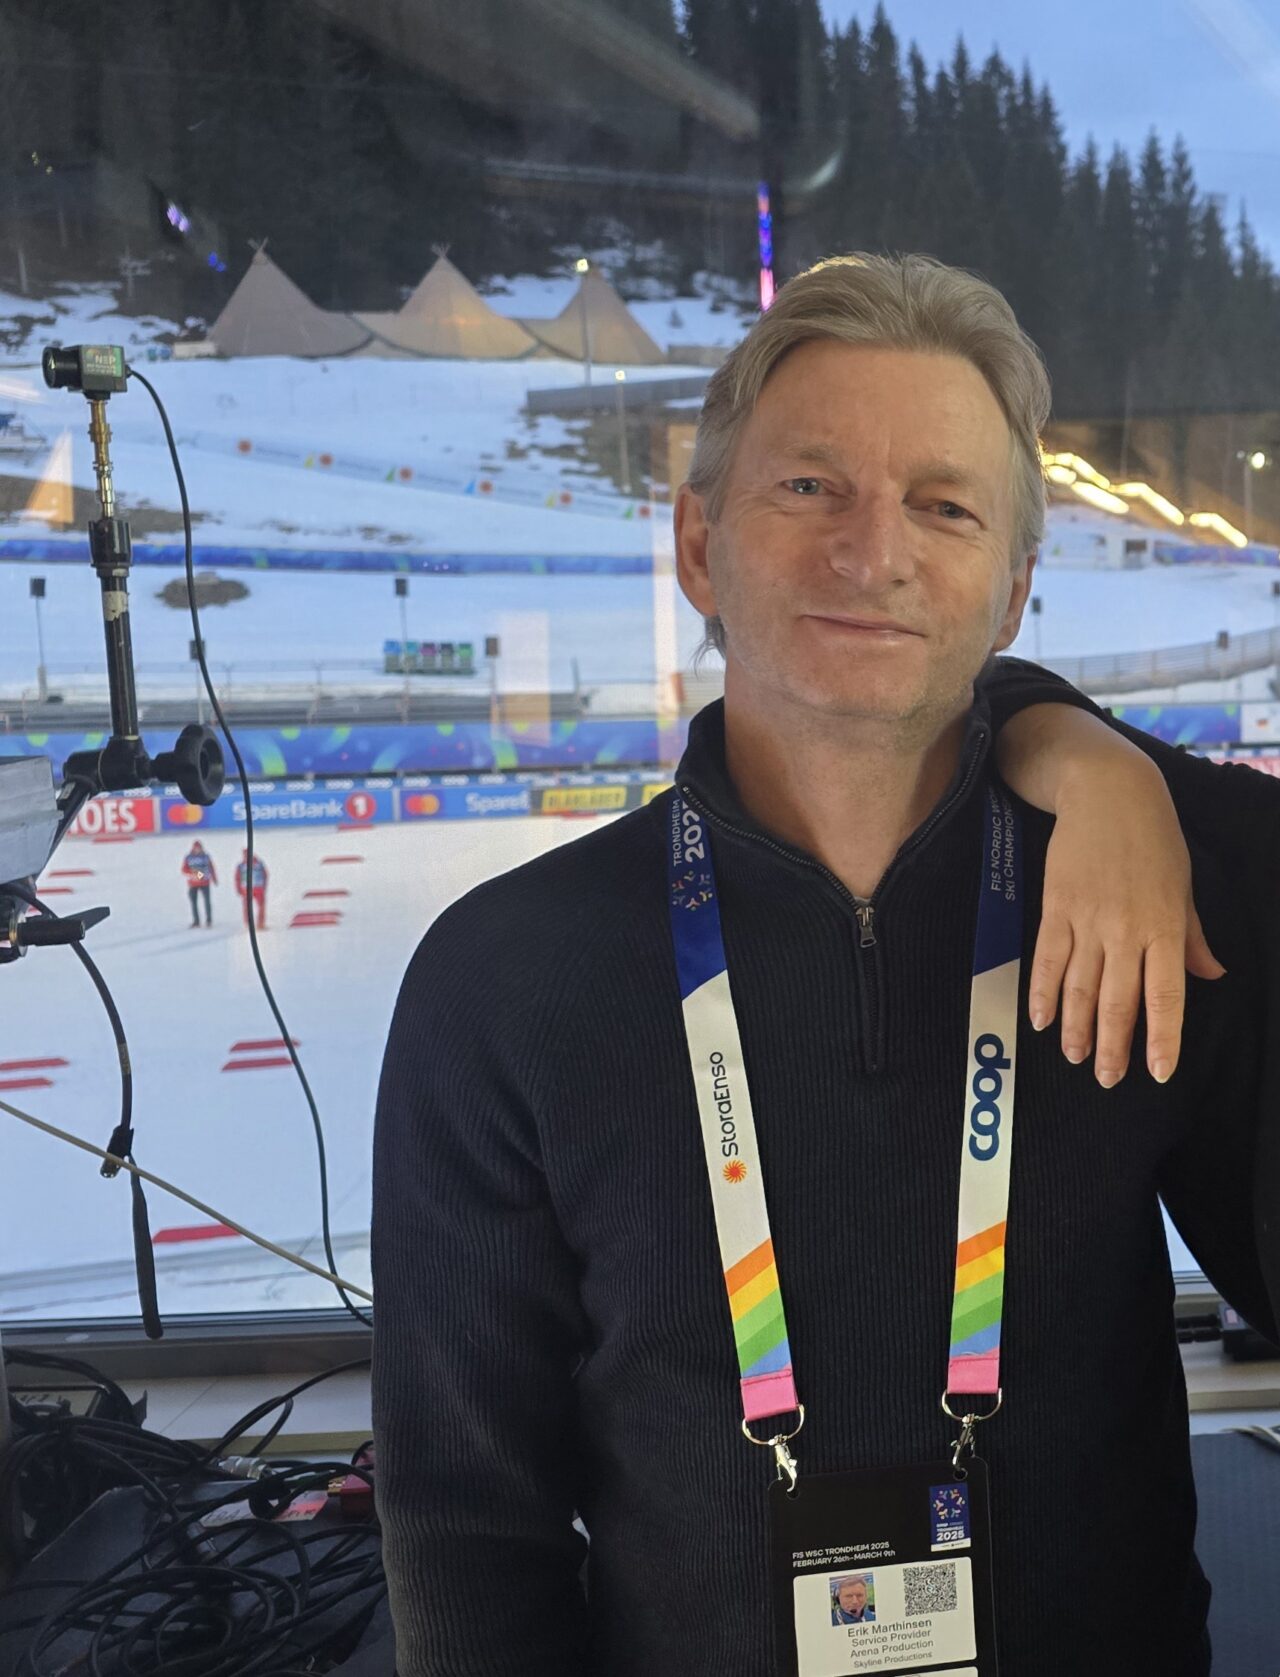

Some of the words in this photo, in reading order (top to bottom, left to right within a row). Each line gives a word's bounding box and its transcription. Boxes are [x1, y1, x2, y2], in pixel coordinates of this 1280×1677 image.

[671, 799, 682, 867] TRONDHEIM
[682, 800, 705, 863] 202
[990, 816, 1002, 869] NORDIC
[990, 871, 1002, 891] FIS
[1004, 880, 1016, 901] SKI
[709, 1051, 740, 1158] StoraEnso
[968, 1032, 1012, 1162] coop
[936, 1530, 965, 1541] 2025
[792, 1551, 804, 1559] FIS
[805, 1549, 823, 1558] WSC
[825, 1543, 869, 1555] TRONDHEIM
[870, 1541, 890, 1550] 2025
[792, 1557, 832, 1568] FEBRUARY
[883, 1549, 896, 1557] 9th
[847, 1626, 869, 1638] Erik
[871, 1619, 932, 1635] Marthinsen
[851, 1635, 888, 1648] Service
[890, 1630, 932, 1642] Provider
[850, 1647, 880, 1658] Arena
[881, 1640, 934, 1654] Production
[884, 1652, 933, 1664] Productions
